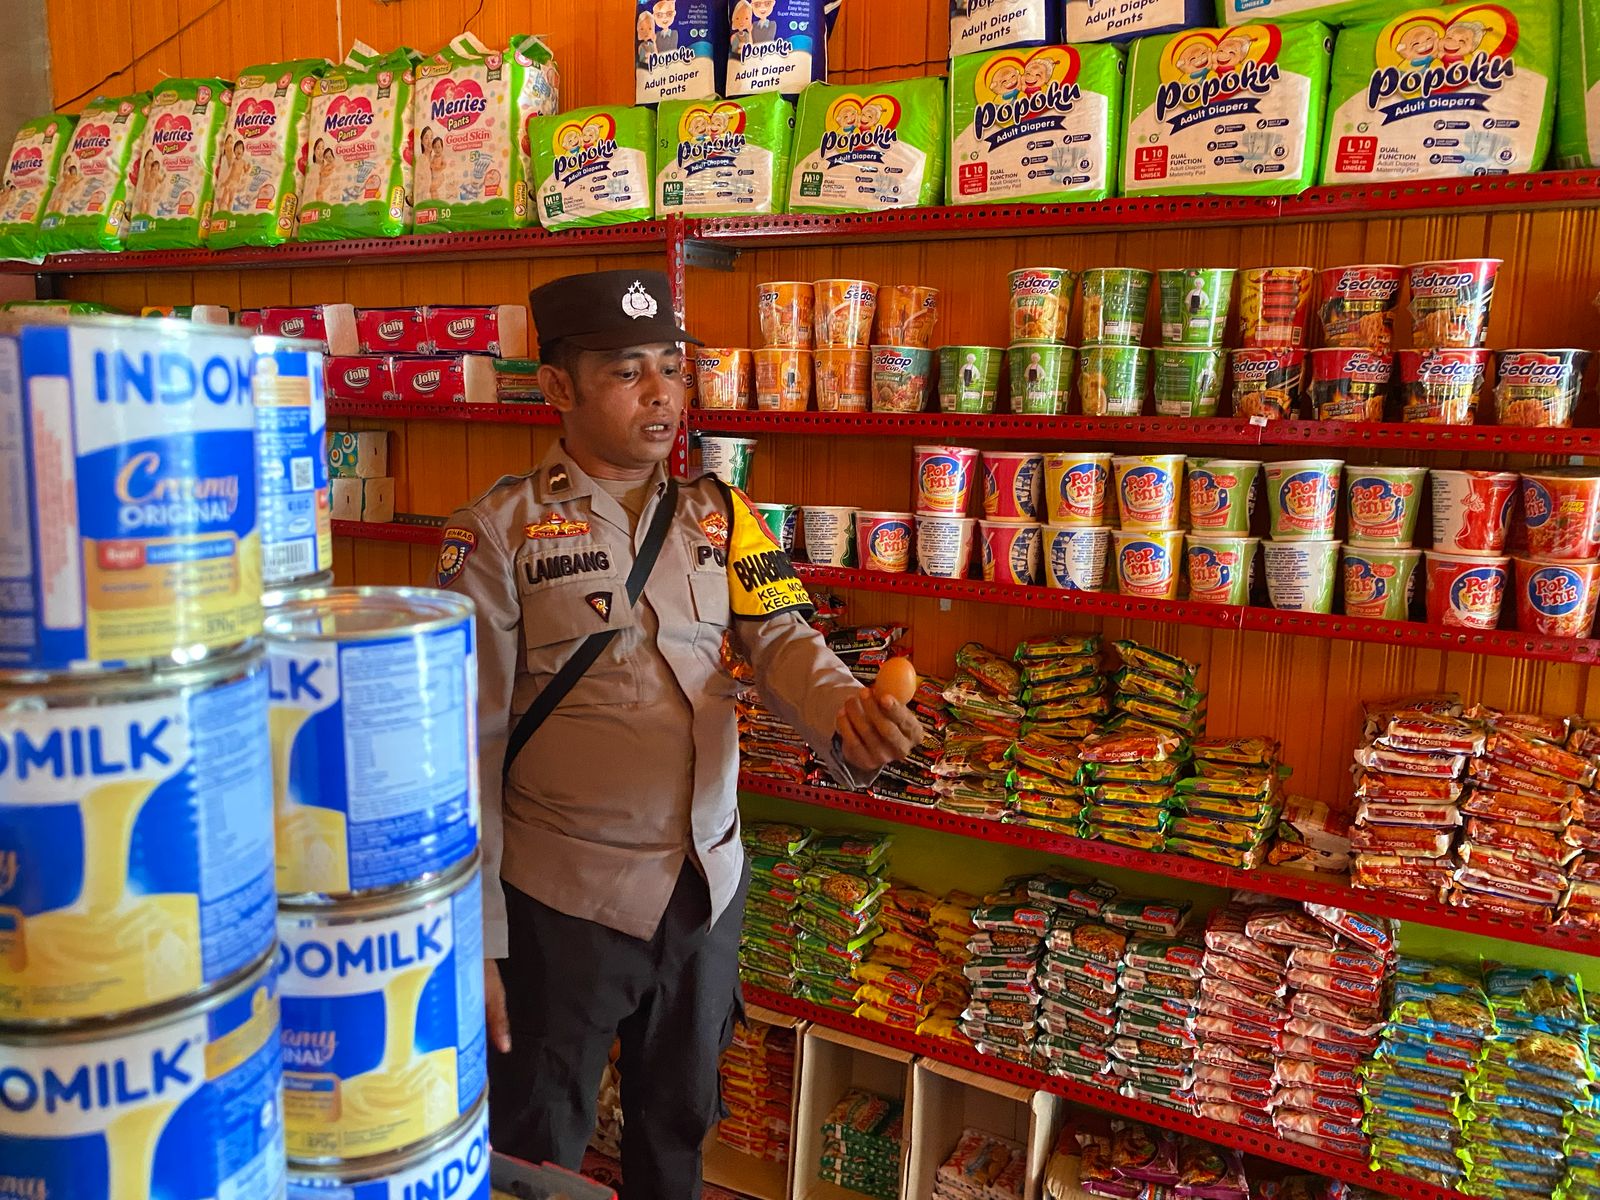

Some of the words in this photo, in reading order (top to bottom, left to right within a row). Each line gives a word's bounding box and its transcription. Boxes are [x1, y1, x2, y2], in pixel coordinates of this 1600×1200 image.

[961, 21, 988, 39] Adult
[990, 7, 1028, 28] Diaper
[1085, 5, 1117, 26] Adult
[1106, 12, 1143, 31] Pants
[979, 25, 1011, 44] Pants
[644, 77, 666, 90] Adult
[669, 70, 699, 83] Diaper
[735, 68, 758, 81] Adult
[762, 64, 796, 75] Diaper
[751, 78, 780, 89] Pants
[1368, 51, 1515, 110] Popoku
[660, 85, 686, 97] Pants
[1156, 60, 1280, 122] Popoku
[431, 93, 487, 120] Merries
[974, 81, 1081, 141] Popoku
[1180, 109, 1205, 126] Adult
[1208, 102, 1249, 116] Diapers
[1395, 101, 1426, 117] Adult
[1429, 97, 1476, 113] Diapers
[234, 111, 277, 130] Merries
[324, 109, 374, 133] Merries
[447, 115, 470, 132] Pants
[152, 126, 194, 146] Merries
[337, 129, 358, 143] Pants
[446, 134, 469, 145] Good
[469, 130, 490, 141] Skin
[996, 126, 1018, 143] Adult
[1020, 120, 1055, 134] Diapers
[73, 131, 111, 151] Merries
[820, 125, 898, 159] Popoku
[1346, 139, 1355, 152] L
[1359, 140, 1371, 149] 10
[161, 144, 180, 155] Pants
[336, 145, 356, 156] Good
[357, 142, 375, 152] Skin
[1142, 150, 1149, 162] L
[1152, 149, 1163, 158] 10
[10, 156, 43, 174] Merries
[834, 155, 851, 164] Adult
[1170, 158, 1203, 166] FUNCTION
[568, 170, 582, 183] Adult
[965, 167, 971, 178] L
[973, 166, 983, 175] 10
[322, 208, 331, 219] 50
[429, 210, 437, 221] M
[441, 208, 451, 219] 50
[1012, 275, 1060, 291] Sedaap
[1337, 277, 1400, 292] Sedaap
[1411, 273, 1474, 288] Sedaap
[1031, 287, 1047, 295] Cup
[1369, 290, 1387, 298] Cup
[1433, 286, 1454, 295] Cup
[285, 317, 304, 330] Jolly
[383, 319, 403, 333] Jolly
[453, 317, 476, 331] Jolly
[349, 367, 369, 380] Jolly
[1234, 359, 1279, 373] edaap
[1418, 361, 1485, 377] Sedaap
[1499, 362, 1574, 377] Sedaap
[418, 369, 440, 384] Jolly
[1530, 376, 1553, 384] Cup
[924, 463, 953, 477] POP
[115, 451, 239, 516] Creamy
[1126, 472, 1157, 491] POP
[1133, 484, 1164, 502] MIE
[1352, 485, 1385, 500] POP
[120, 501, 232, 528] ORIGINAL
[879, 527, 905, 543] POP
[1124, 547, 1154, 564] POP
[524, 550, 610, 585] LAMBANG
[1130, 558, 1162, 576] MIE
[1535, 576, 1569, 594] POP
[1541, 587, 1578, 606] MIE
[1512, 722, 1547, 734] GORENG
[0, 717, 172, 780] MILK
[1419, 738, 1451, 748] GORENG
[1111, 750, 1138, 759] GORENG
[1405, 762, 1438, 773] GORENG
[1524, 756, 1558, 771] GORENG
[1396, 789, 1429, 797] GORENG
[1510, 779, 1544, 793] GORENG
[1393, 810, 1426, 819] GORENG
[1506, 807, 1541, 821] GORENG
[1384, 840, 1417, 849] GORENG
[1495, 881, 1530, 894] GORENG
[1002, 1037, 1017, 1045] ACEH
[1163, 1037, 1180, 1046] ACEH
[0, 1040, 194, 1114] OMILK
